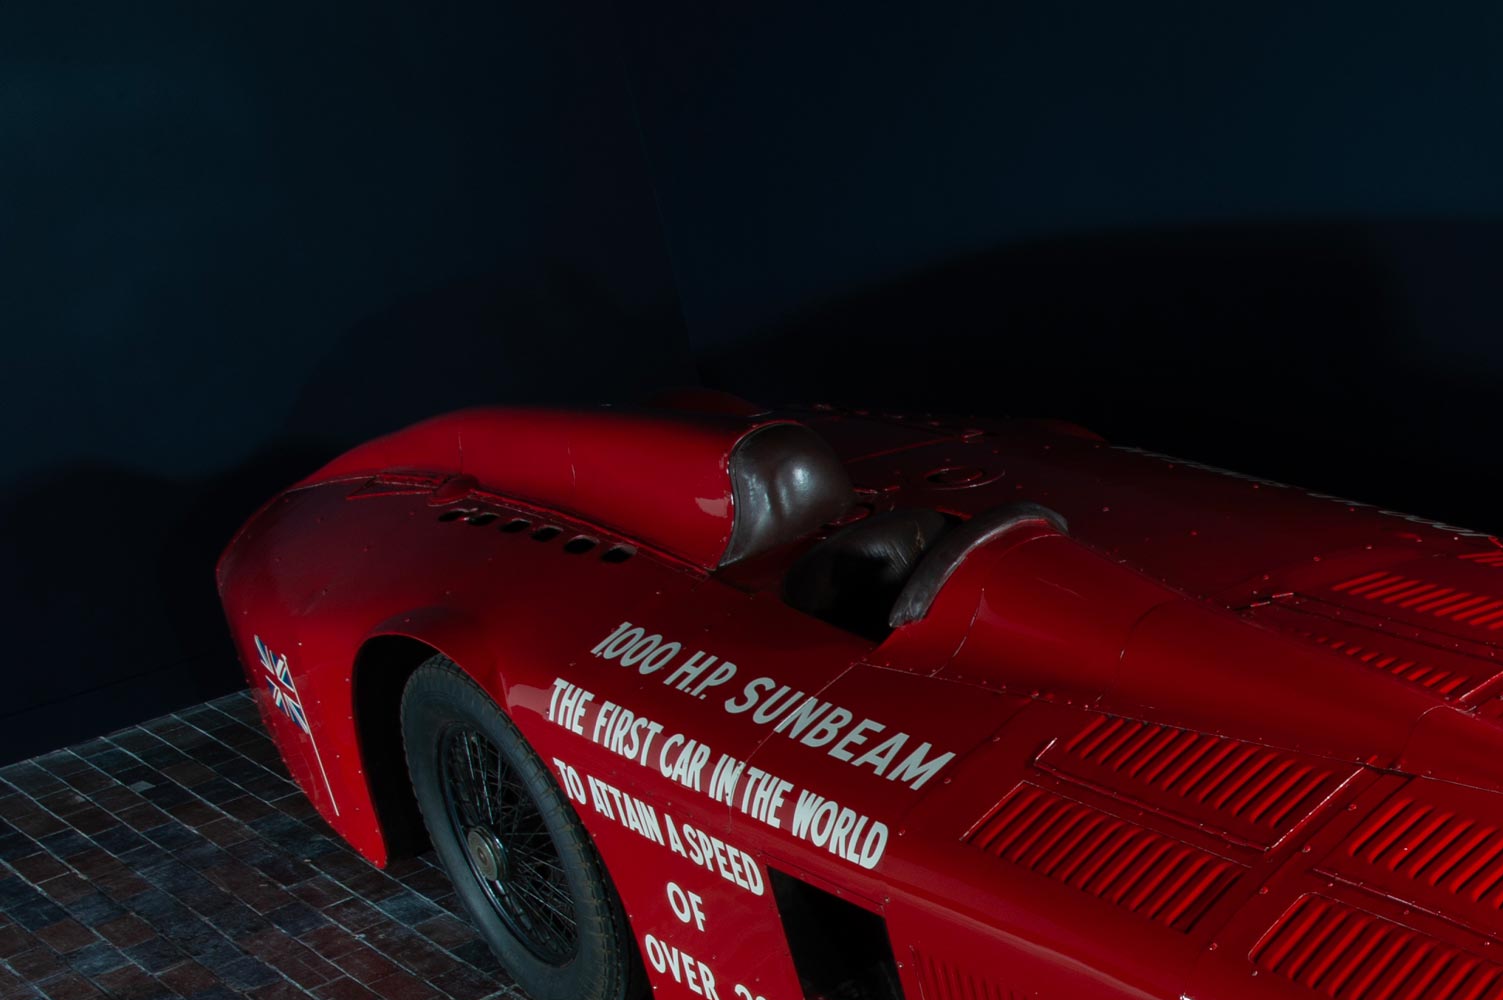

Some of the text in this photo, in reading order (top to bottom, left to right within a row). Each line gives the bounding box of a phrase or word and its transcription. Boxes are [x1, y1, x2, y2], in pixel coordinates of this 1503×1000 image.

[548, 677, 889, 870] THE FIRST CAR IN THE WORLD
[663, 650, 738, 700] H.P.
[724, 676, 957, 791] SUNBEAM
[552, 757, 765, 897] TO ATTAIN A SPEED
[666, 881, 707, 933] OF
